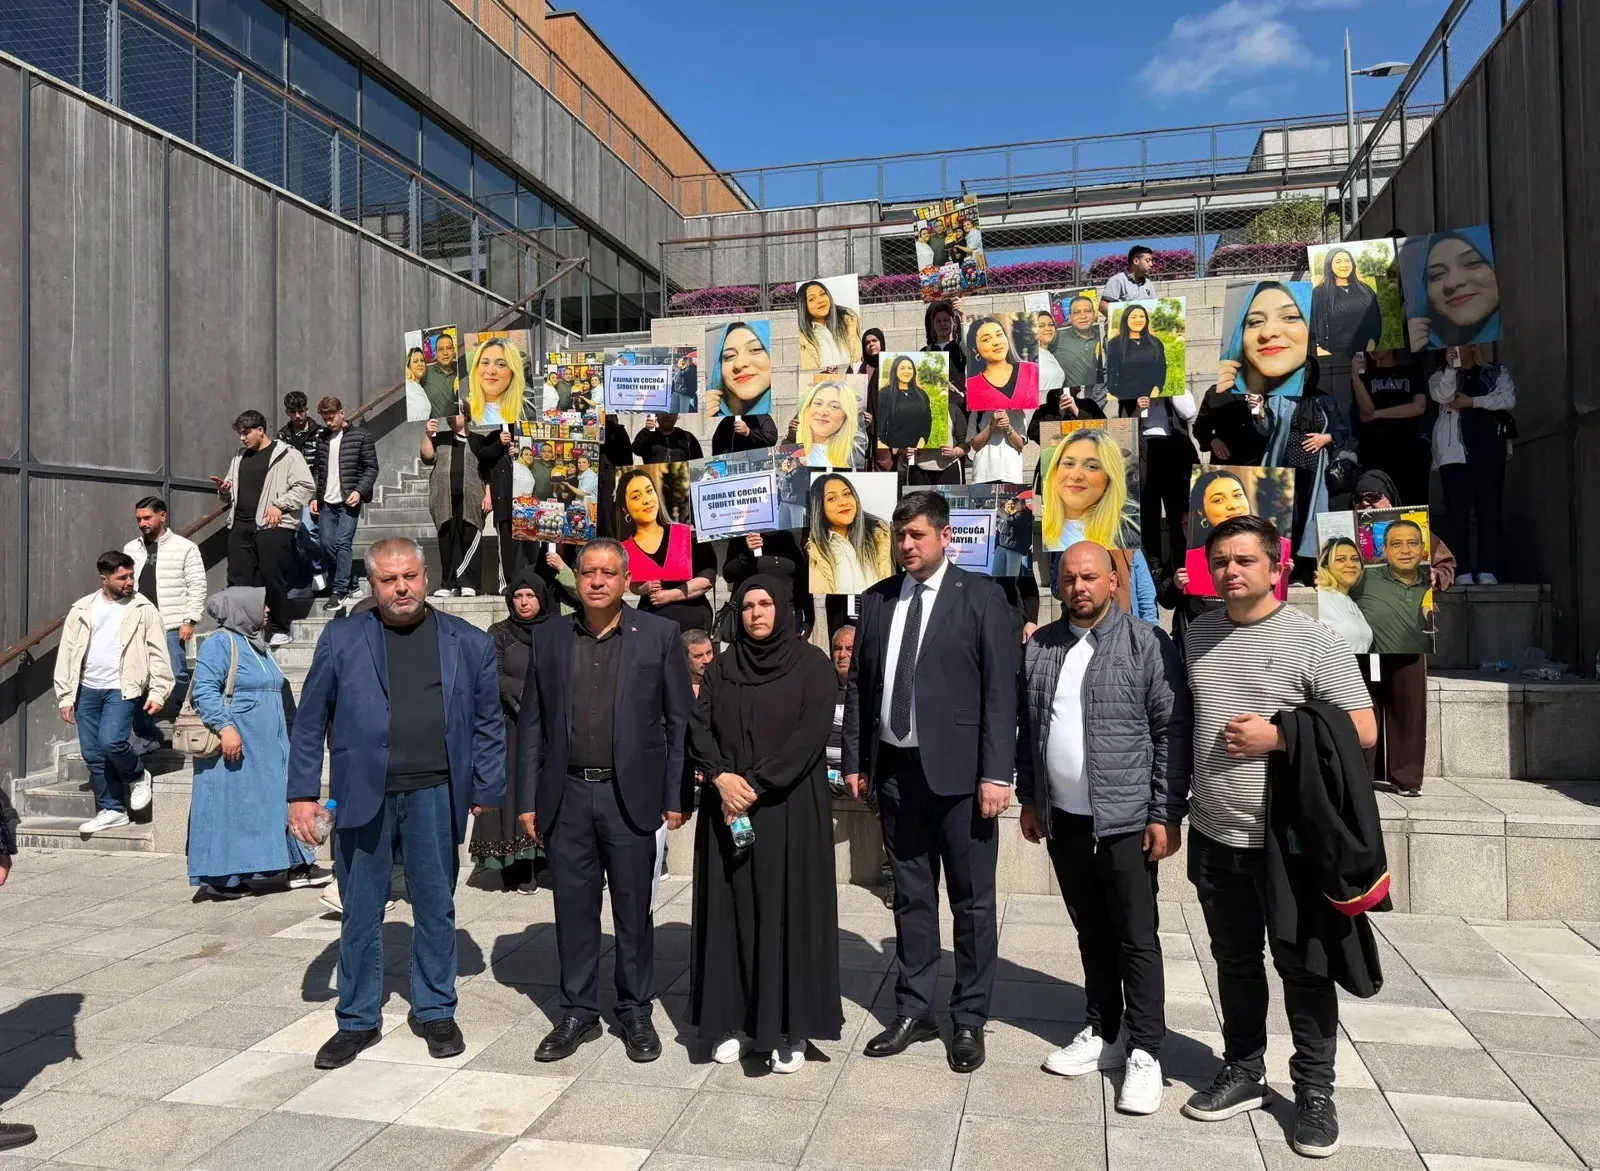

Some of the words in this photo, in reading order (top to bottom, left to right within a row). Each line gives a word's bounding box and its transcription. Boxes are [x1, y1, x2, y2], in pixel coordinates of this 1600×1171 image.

[640, 376, 665, 384] ÇOCUĞA
[702, 491, 727, 502] KADINA
[727, 490, 736, 498] VE
[737, 486, 768, 497] ÇOCUĞA
[708, 499, 736, 510] ŞİDDETE
[736, 497, 758, 506] HAYIR
[952, 525, 985, 536] ÇOCUĞA
[950, 536, 973, 544] HAYIR
